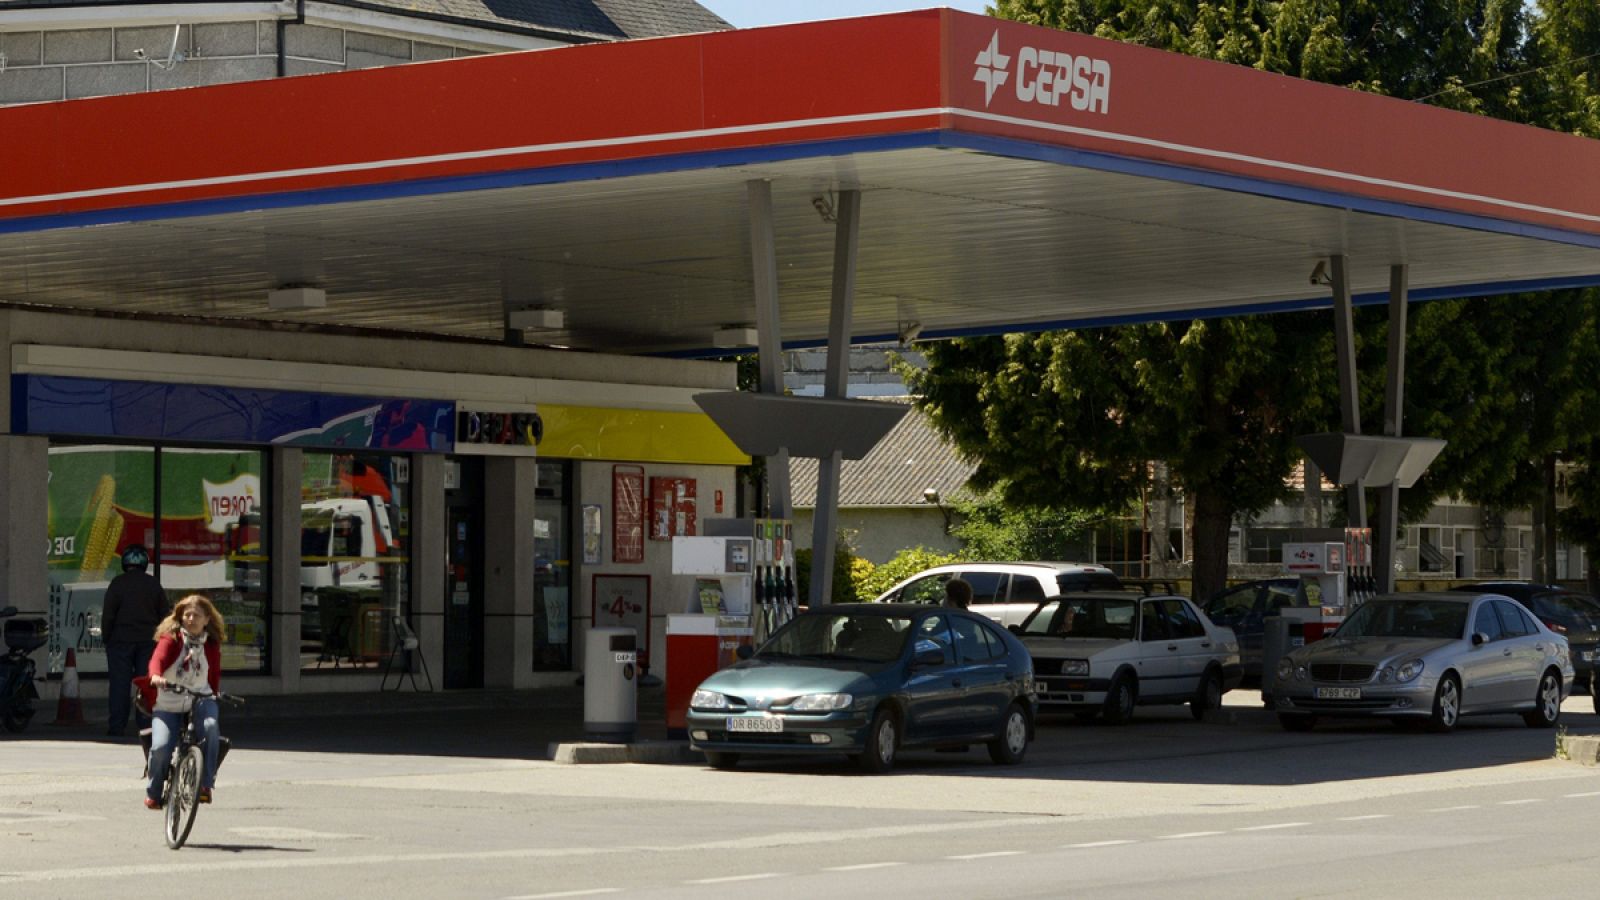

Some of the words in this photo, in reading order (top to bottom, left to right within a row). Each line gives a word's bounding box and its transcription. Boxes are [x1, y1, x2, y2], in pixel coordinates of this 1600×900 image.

[1015, 46, 1112, 115] CEPSA
[747, 718, 773, 731] 8650
[774, 718, 782, 731] S
